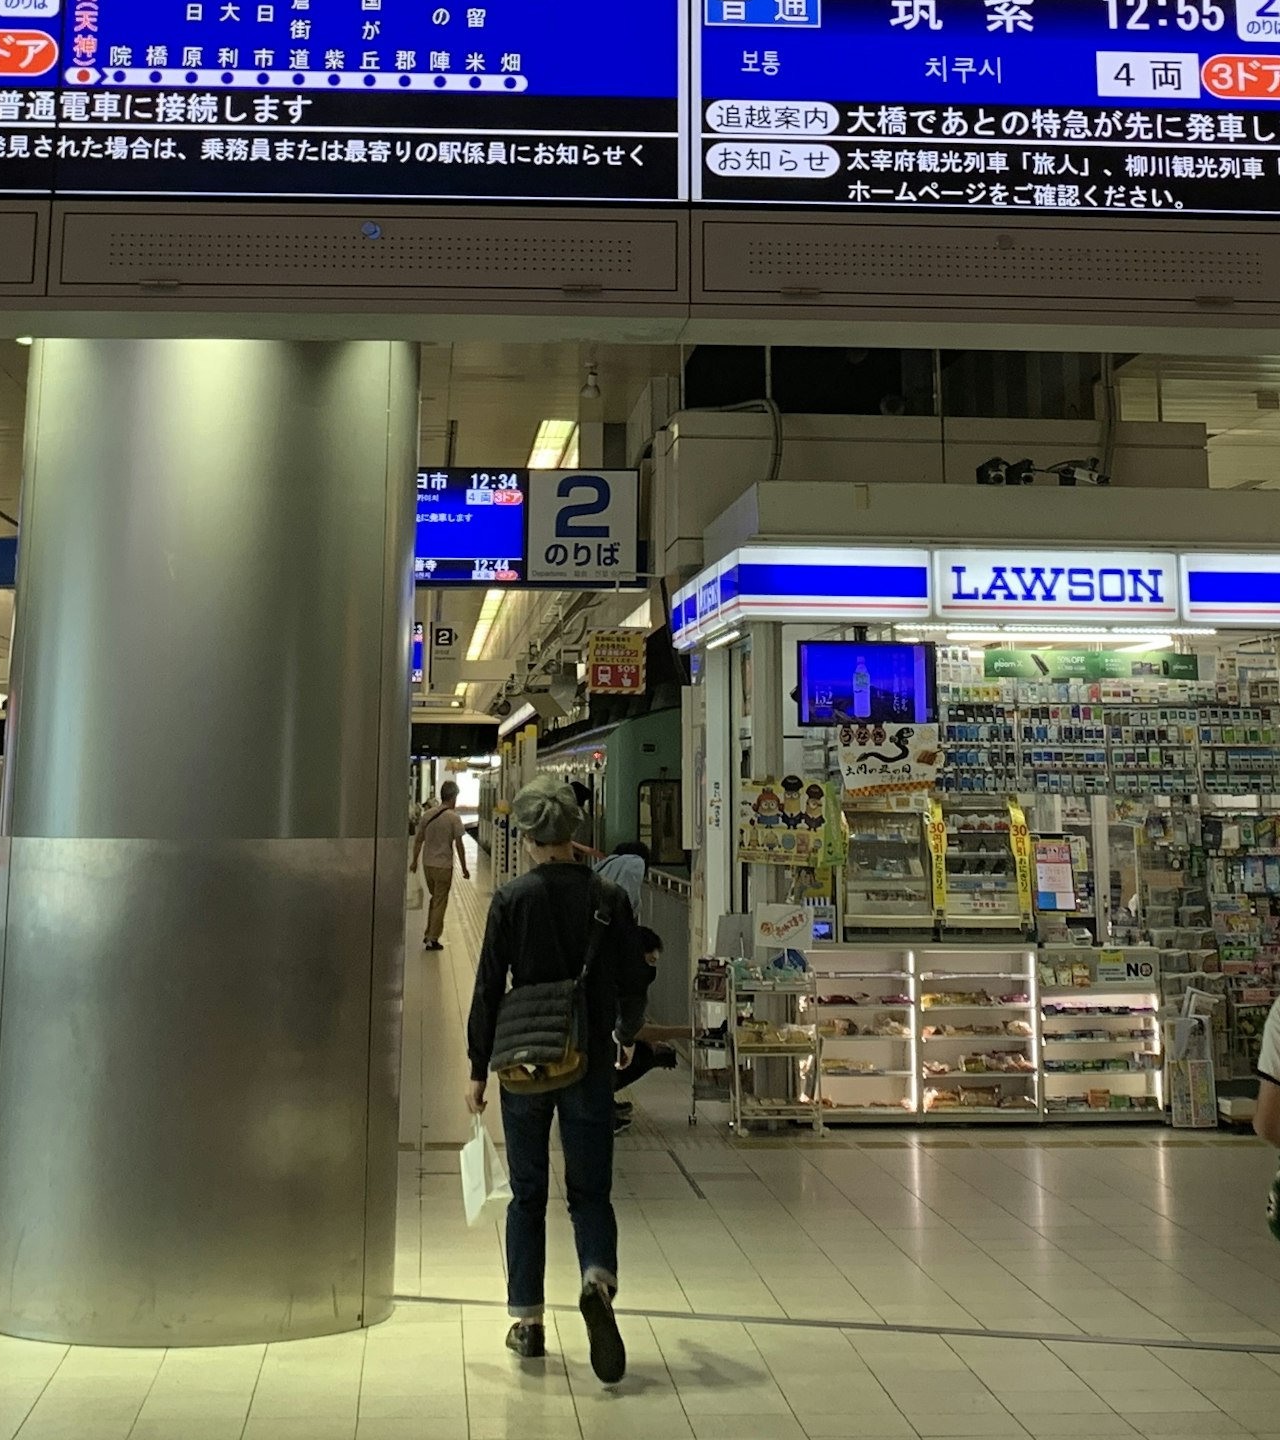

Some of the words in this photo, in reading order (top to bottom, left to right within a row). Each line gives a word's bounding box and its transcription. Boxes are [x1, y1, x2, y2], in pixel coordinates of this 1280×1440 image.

[924, 55, 1004, 85] 치쿠시
[1113, 62, 1183, 91] 4両
[716, 105, 830, 130] 追越案内
[717, 147, 830, 173] お知らせ
[847, 180, 1187, 210] ホームページをご確認ください。
[469, 473, 519, 491] 12:34
[554, 474, 612, 538] 2
[543, 541, 622, 567] のりば
[950, 565, 1165, 604] LAWSON
[437, 630, 451, 644] 2
[929, 822, 946, 834] 30
